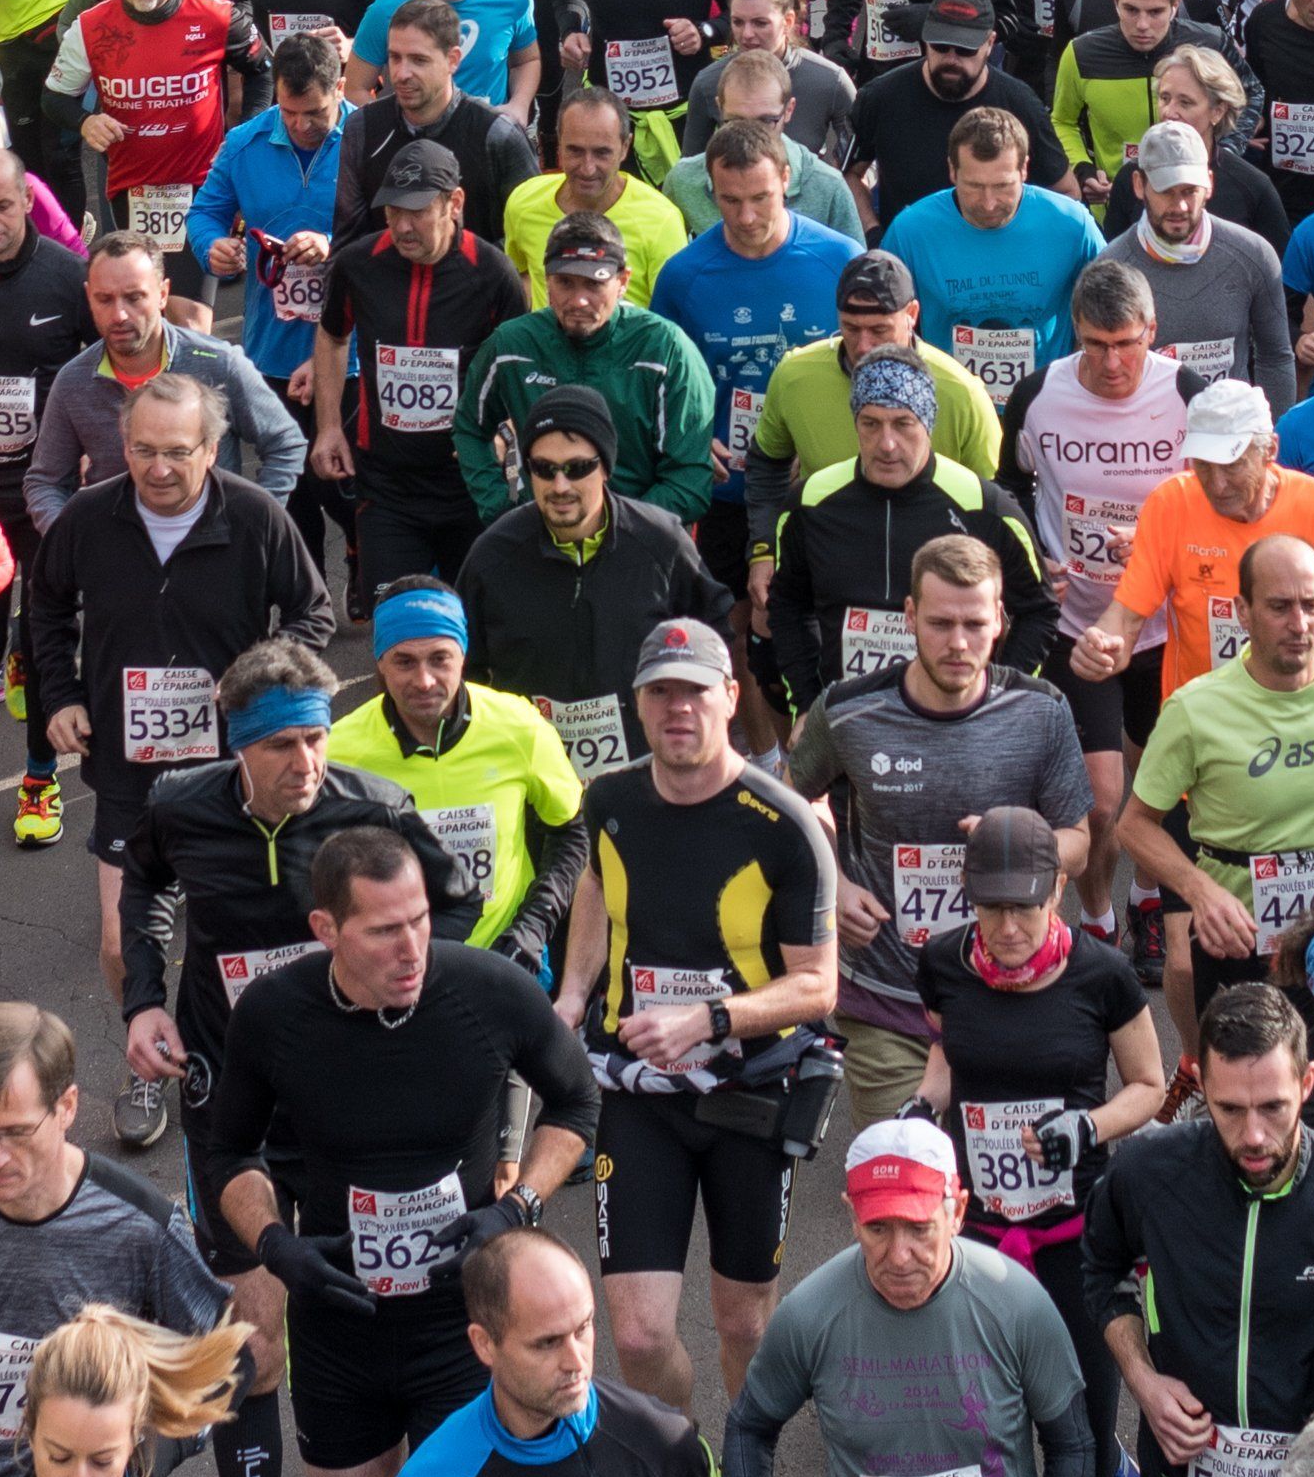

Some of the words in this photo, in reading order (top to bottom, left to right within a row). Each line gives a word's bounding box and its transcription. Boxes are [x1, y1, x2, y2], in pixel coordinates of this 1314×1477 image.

[99, 69, 213, 99] ROUGEOT
[610, 64, 674, 93] 3952
[146, 90, 209, 110] TRIATHLON
[136, 211, 184, 235] 3819
[977, 339, 1031, 348] D'EPARGNE
[989, 331, 1020, 339] CAISSE
[381, 382, 455, 410] 4082
[163, 670, 198, 680] CAISSE
[151, 679, 213, 691] D'EPARGNE
[566, 700, 601, 713] CAISSE
[129, 705, 213, 741] 5334
[155, 748, 175, 759] new
[177, 744, 216, 756] balance
[565, 734, 624, 768] 792
[895, 757, 922, 774] dpd
[904, 783, 923, 792] 2017
[438, 809, 477, 820] CAISSE
[1003, 1103, 1046, 1115] CAISSE
[384, 1192, 459, 1217] D'EPARGNE
[398, 1187, 441, 1205] CAISSE
[842, 1354, 993, 1374] SEMI-MARATHON
